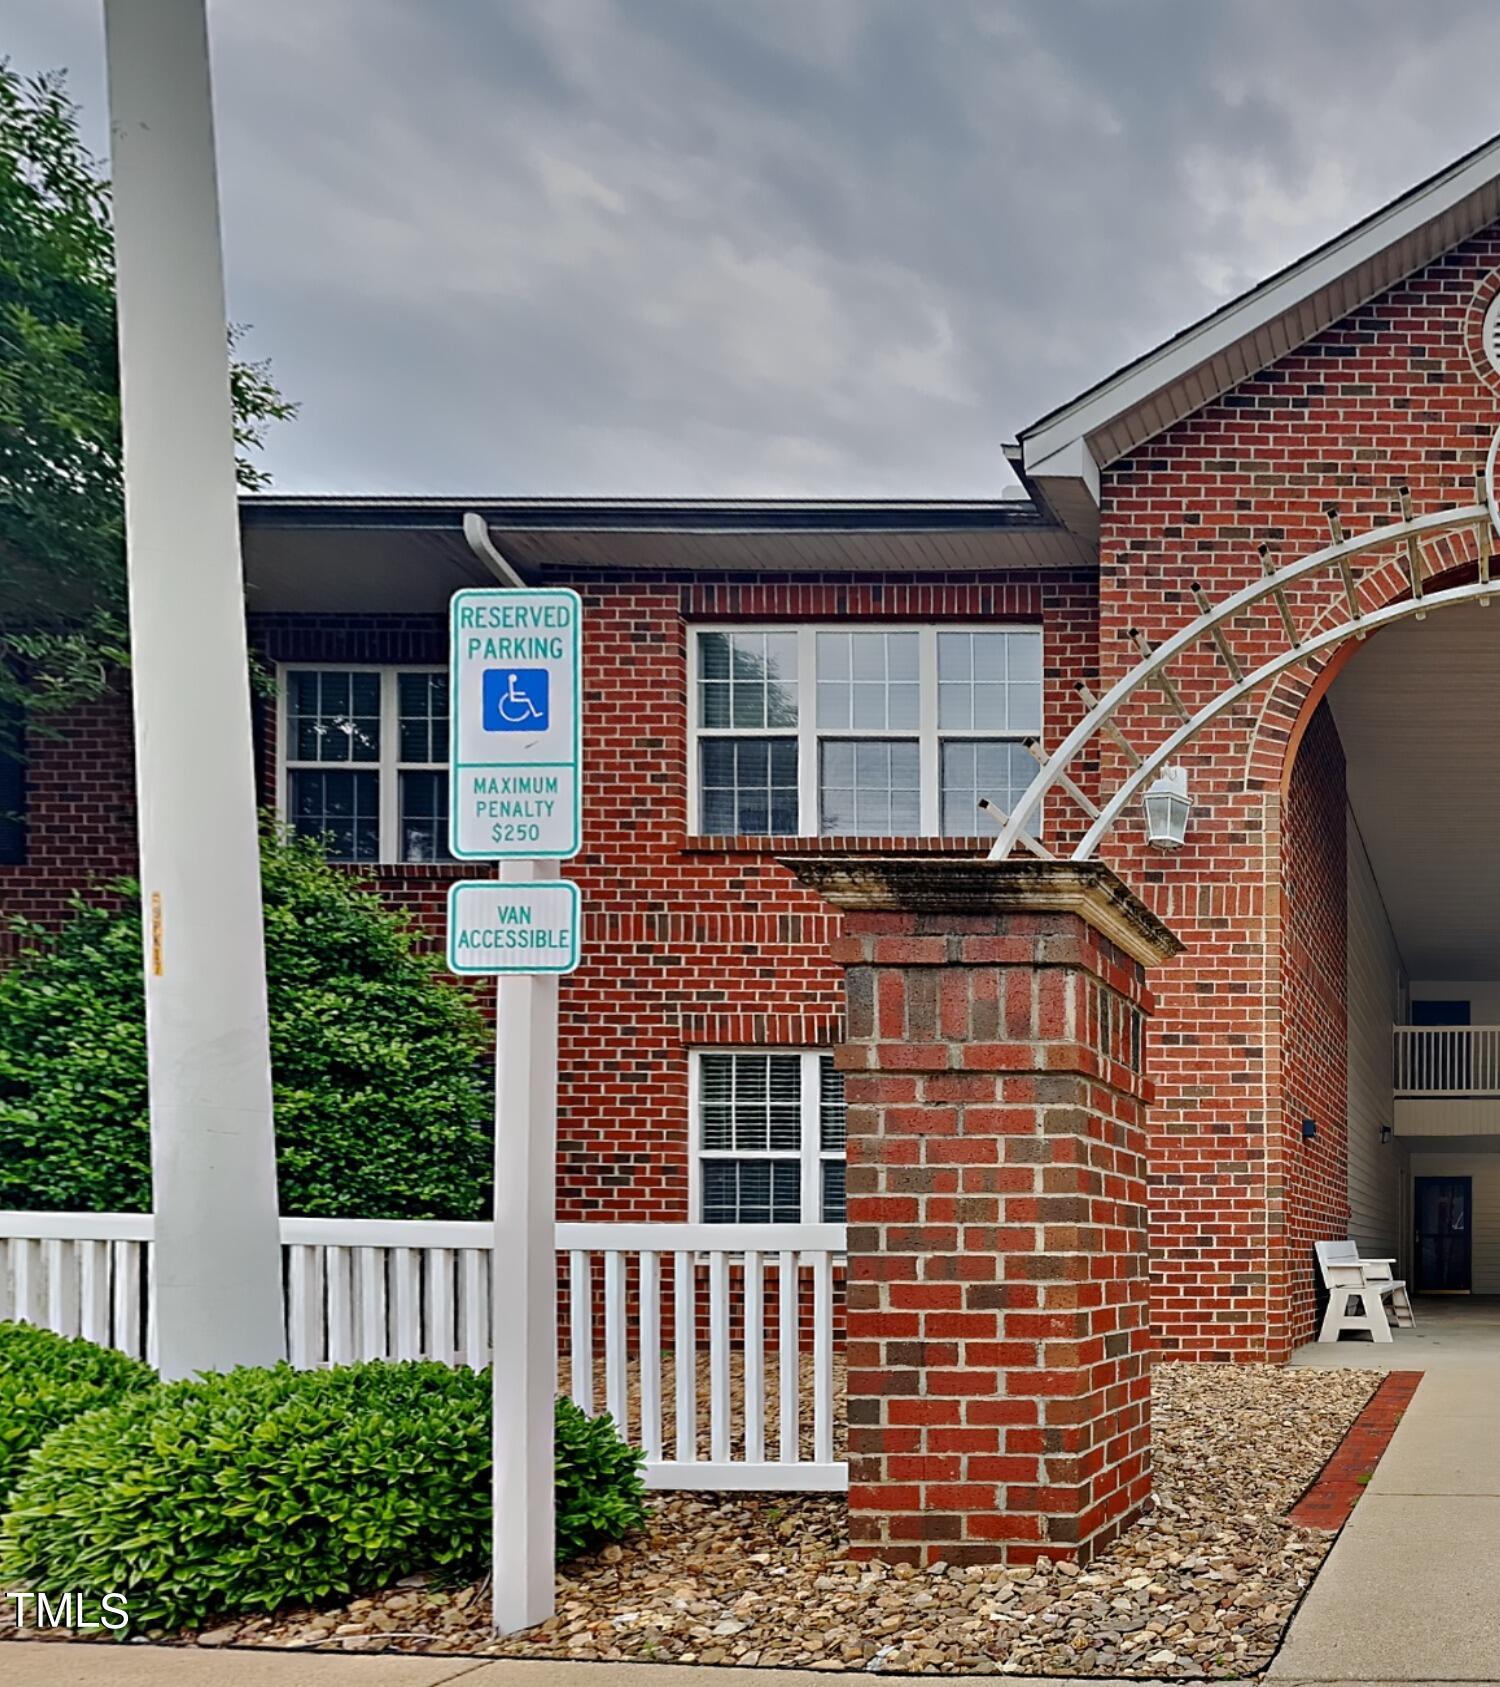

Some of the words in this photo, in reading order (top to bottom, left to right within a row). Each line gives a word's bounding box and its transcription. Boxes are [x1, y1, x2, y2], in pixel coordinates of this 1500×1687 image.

[460, 606, 570, 629] RESERVED
[468, 637, 563, 660] PARKING
[473, 777, 558, 794] MAXIMUM
[476, 800, 555, 818] PENALTY
[491, 822, 540, 844] $250
[497, 905, 532, 925] VAN
[458, 929, 570, 949] ACCESSIBLE
